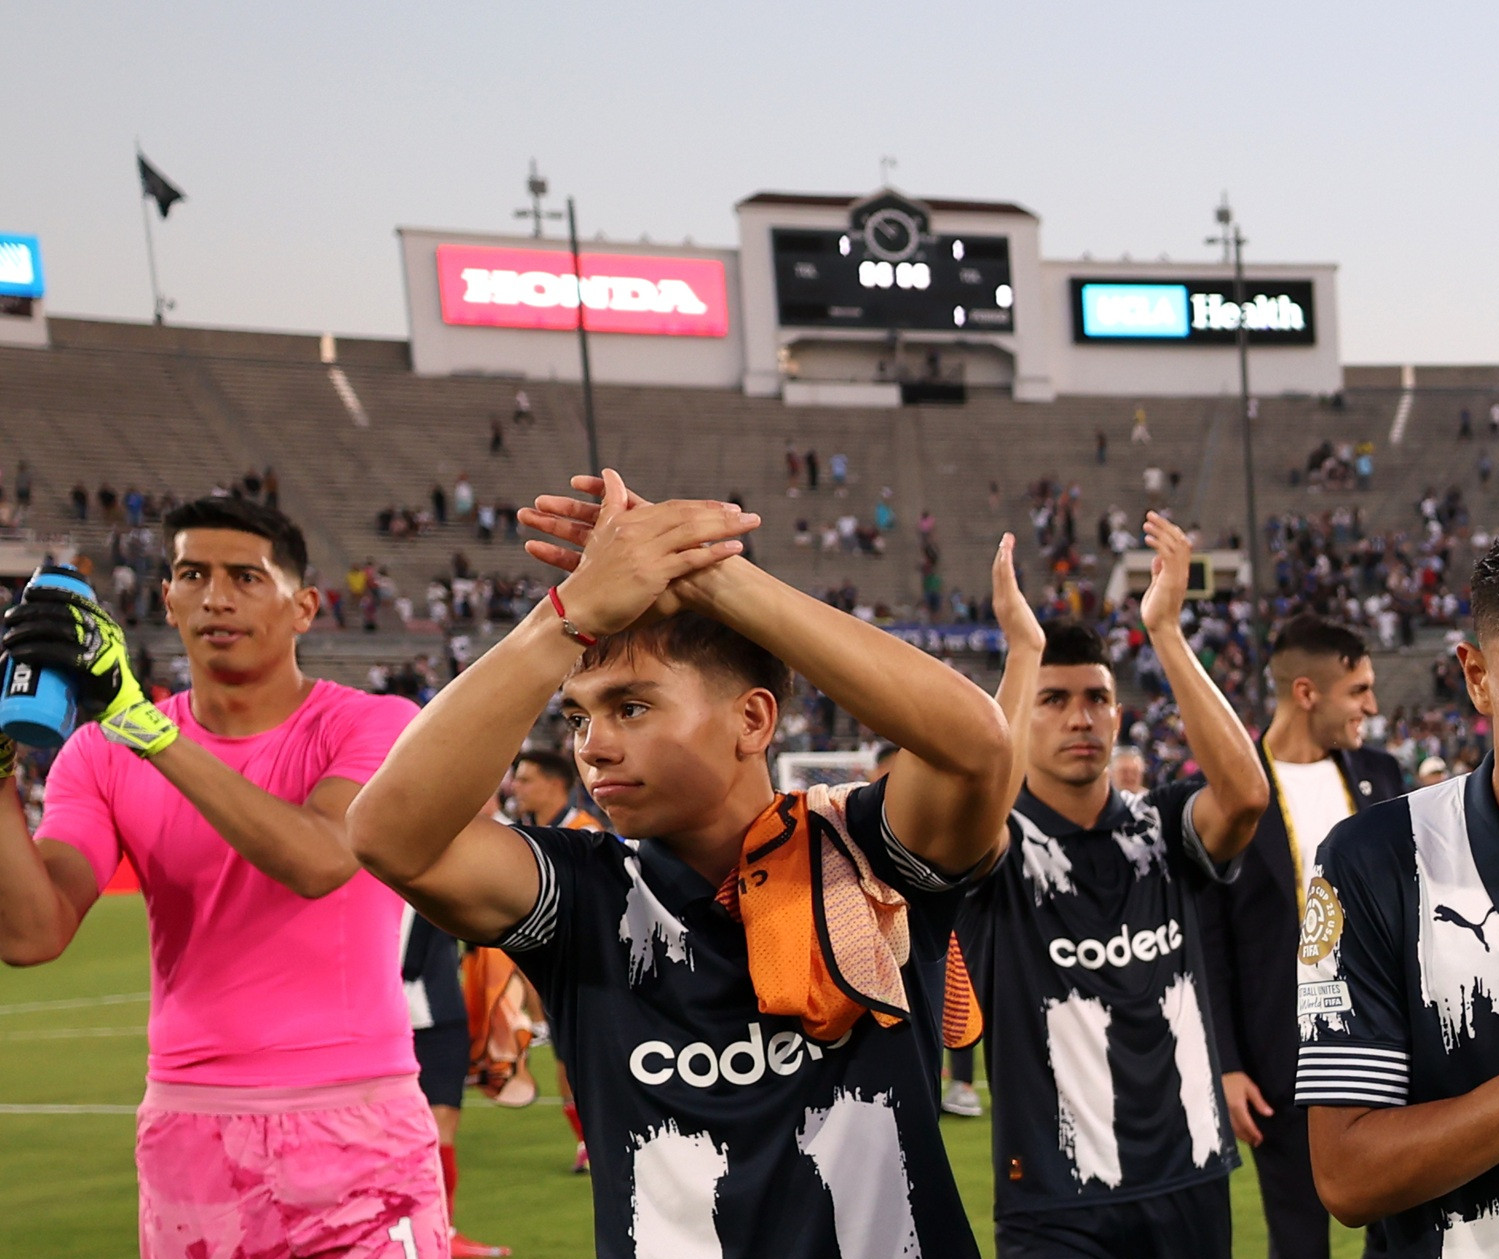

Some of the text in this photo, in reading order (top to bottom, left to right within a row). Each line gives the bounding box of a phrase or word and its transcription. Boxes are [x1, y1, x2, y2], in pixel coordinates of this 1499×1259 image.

[461, 267, 708, 315] HONDA
[1189, 293, 1306, 330] Health
[1048, 918, 1184, 971] codere
[1302, 944, 1320, 958] FIFA
[1324, 997, 1343, 1008] FIFA
[629, 1022, 853, 1088] code
